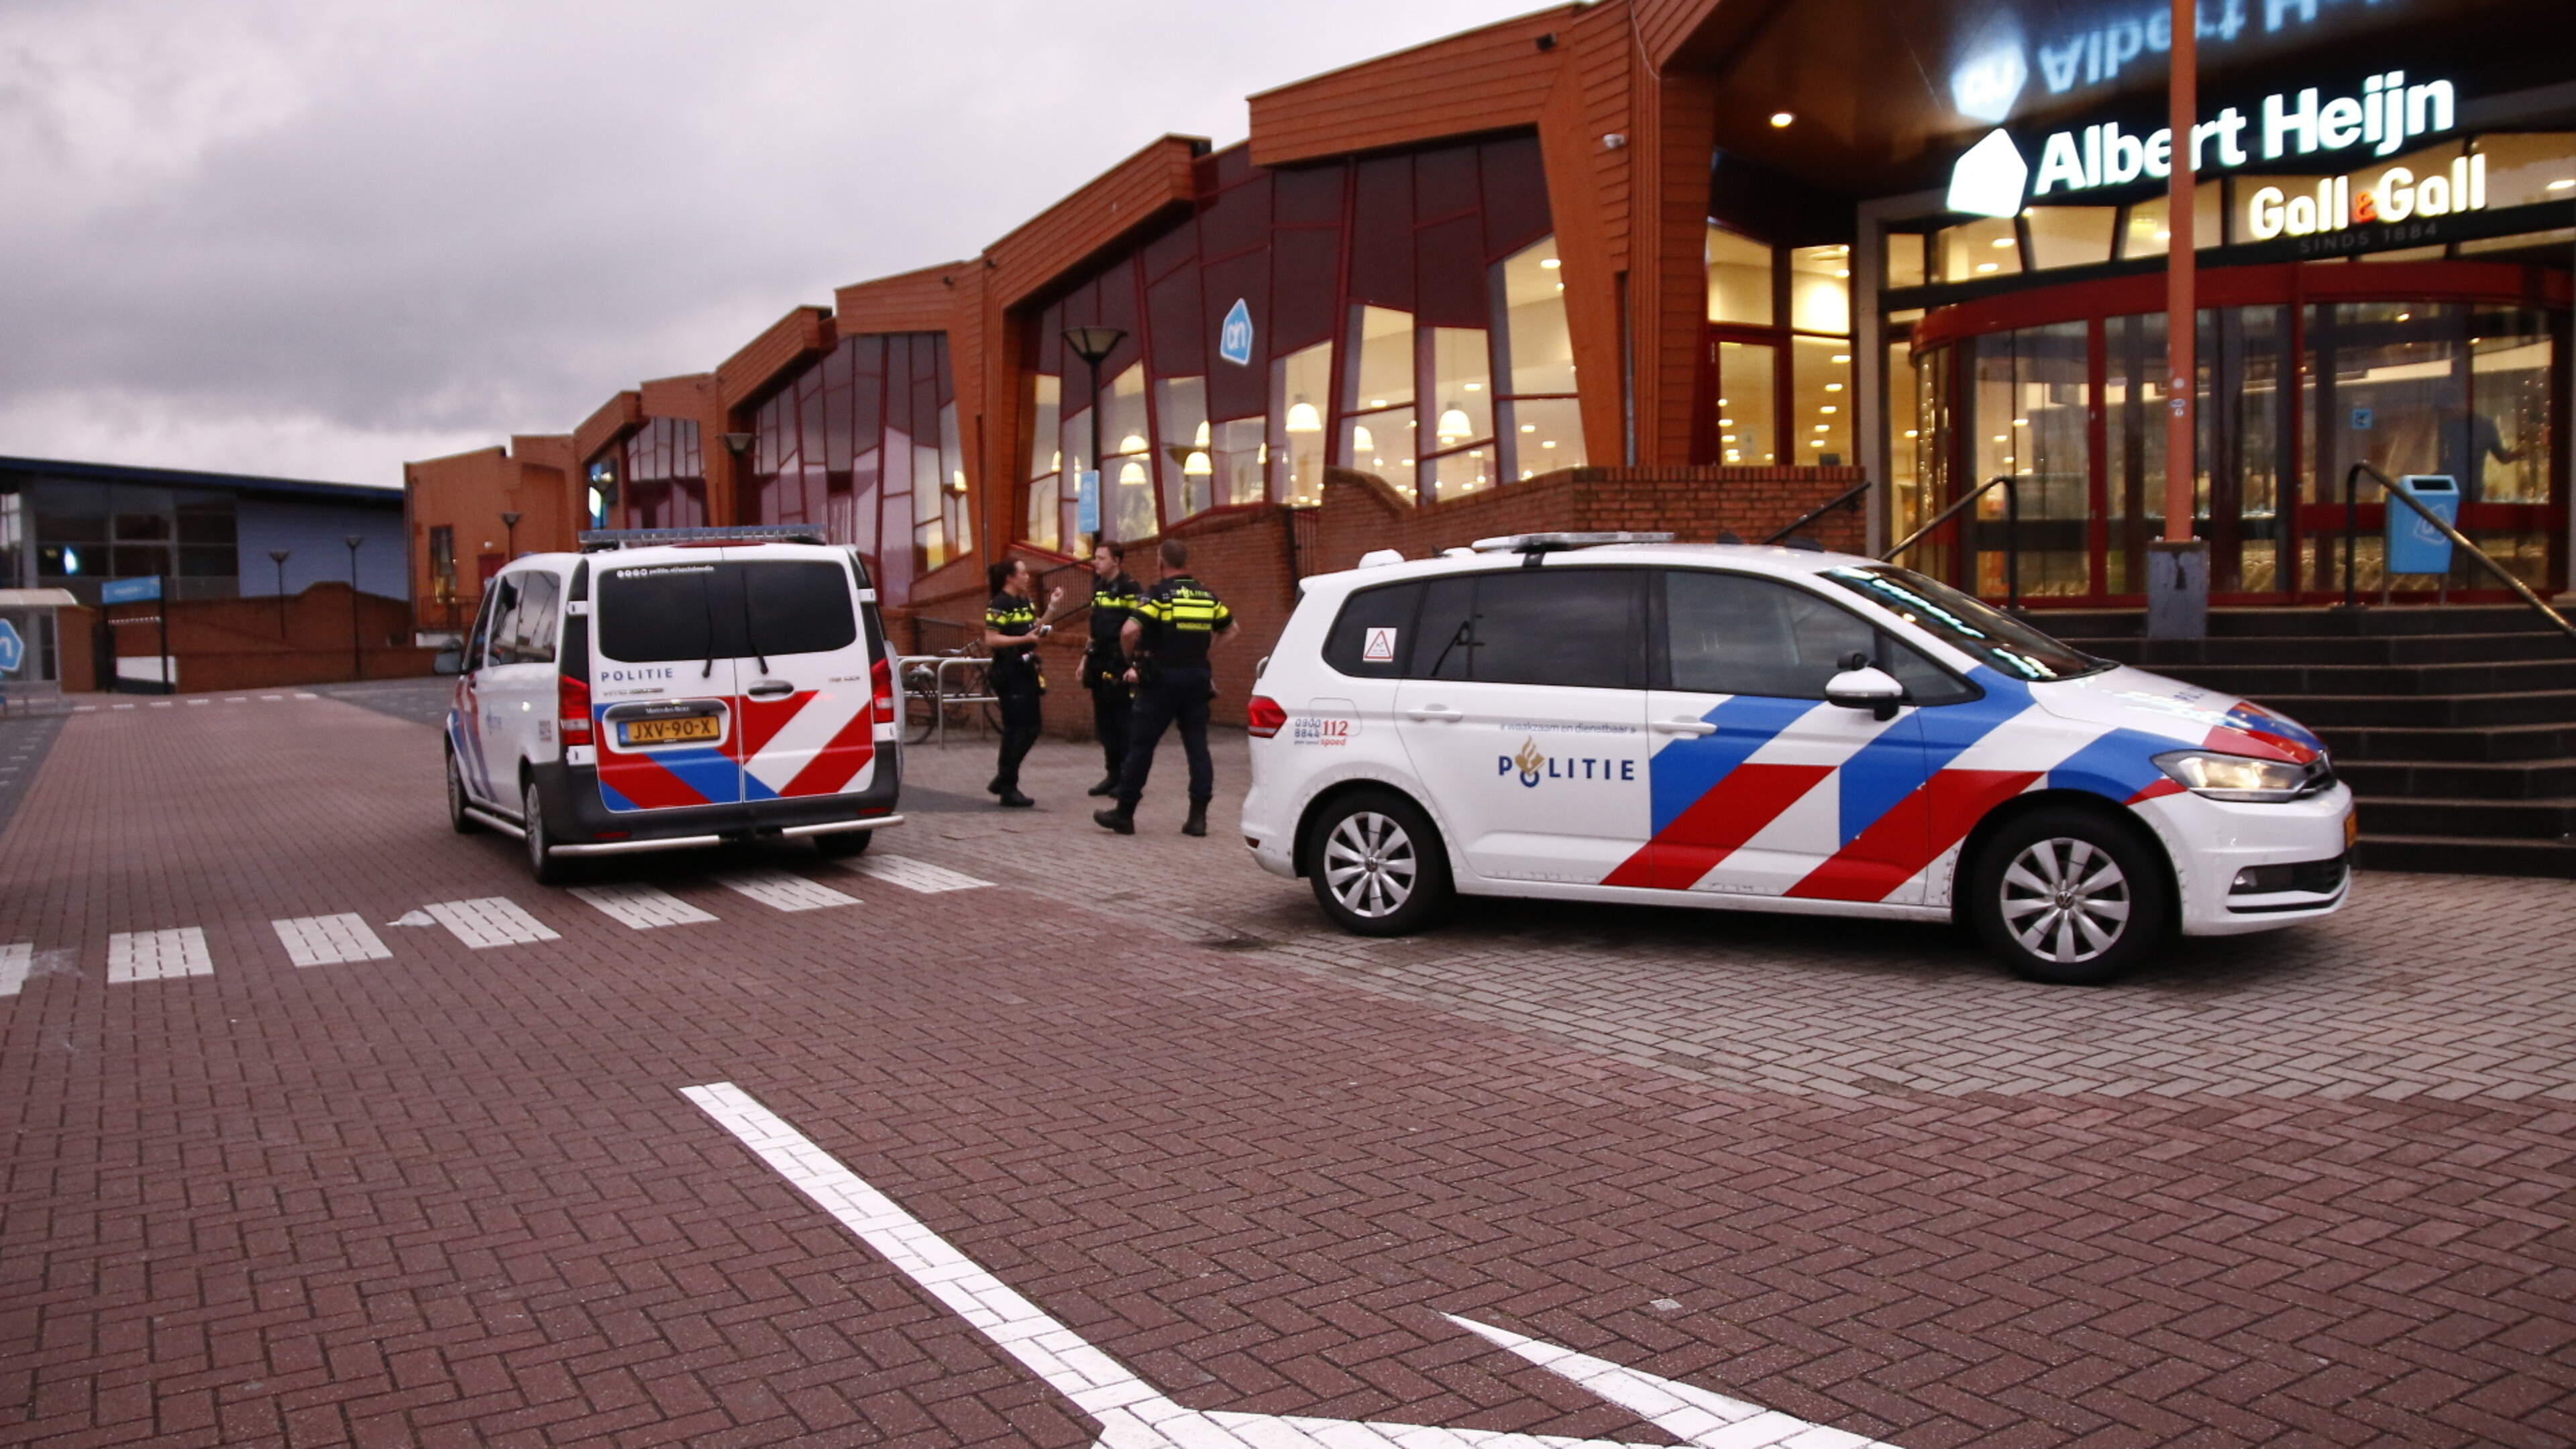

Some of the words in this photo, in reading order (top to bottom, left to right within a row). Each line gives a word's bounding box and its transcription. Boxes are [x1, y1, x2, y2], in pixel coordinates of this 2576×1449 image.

[2034, 107, 2247, 195] Albert
[2263, 70, 2454, 158] Heijn
[2249, 175, 2349, 240] Gall
[2378, 153, 2486, 223] Gall
[2300, 231, 2370, 254] SINDS
[2384, 223, 2438, 243] 1884
[601, 668, 674, 682] POLITIE
[633, 718, 712, 740] JXV-90-X
[1295, 718, 1321, 727] 0900
[1322, 720, 1348, 736] 112
[1507, 722, 1559, 732] waakzaam
[1560, 724, 1574, 733] en
[1576, 722, 1627, 733] dienstbaar
[1294, 729, 1320, 737] 8844
[1320, 738, 1346, 747] spoed
[1499, 755, 1635, 788] POLITIE
